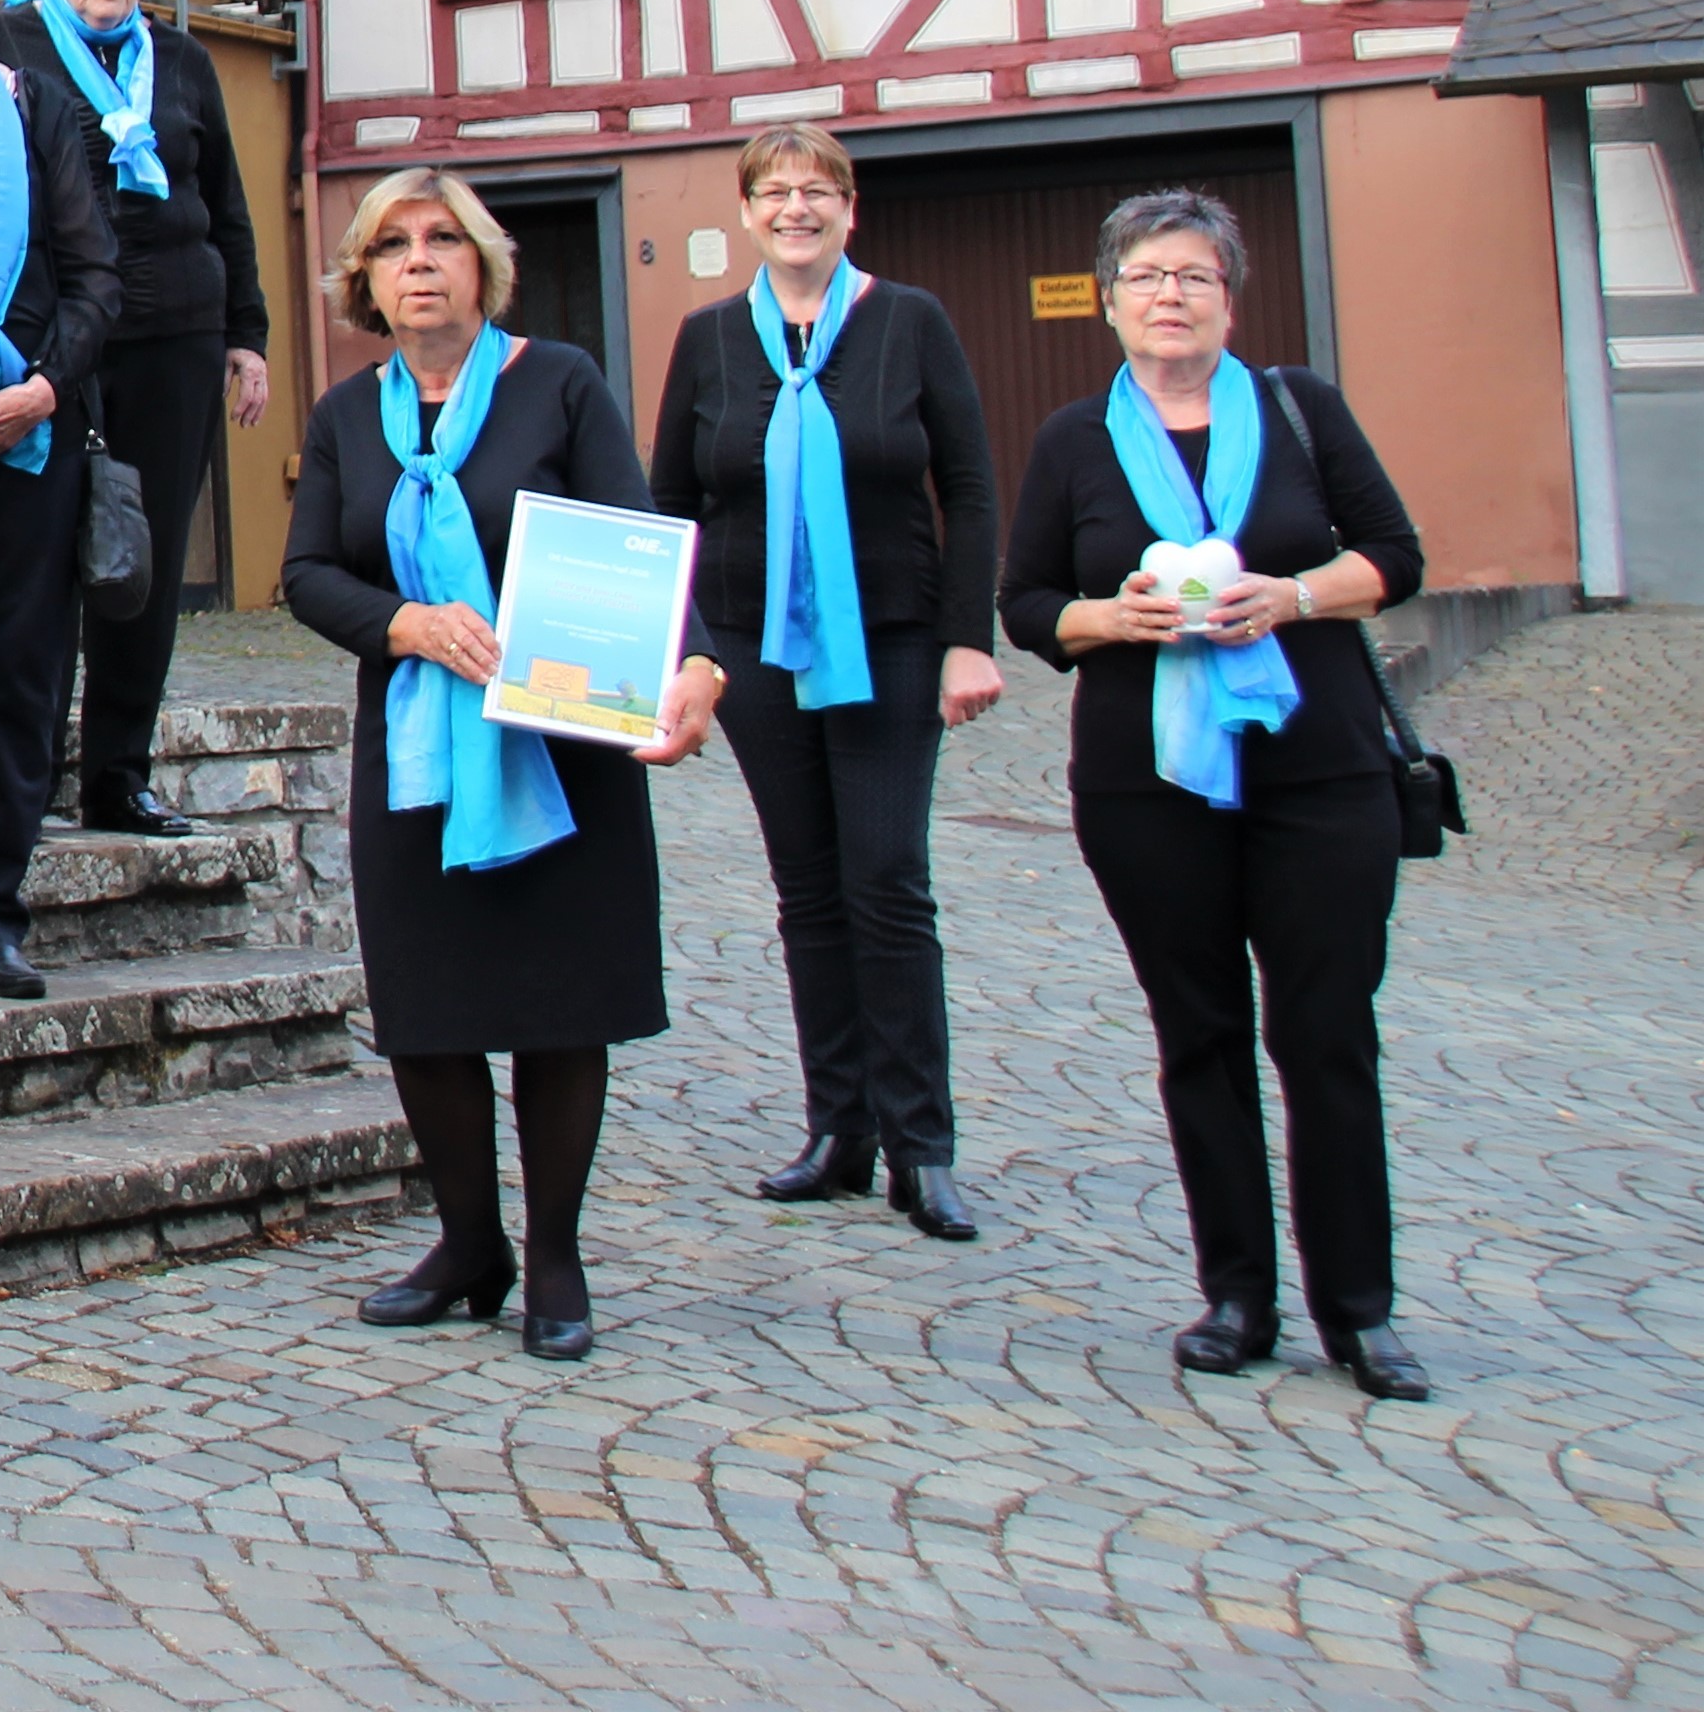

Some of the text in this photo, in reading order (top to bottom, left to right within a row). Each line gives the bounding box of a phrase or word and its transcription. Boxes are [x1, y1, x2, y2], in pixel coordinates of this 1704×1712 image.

[640, 239, 654, 264] 8
[1040, 279, 1084, 293] Einfahrt
[1037, 297, 1092, 309] freihalten
